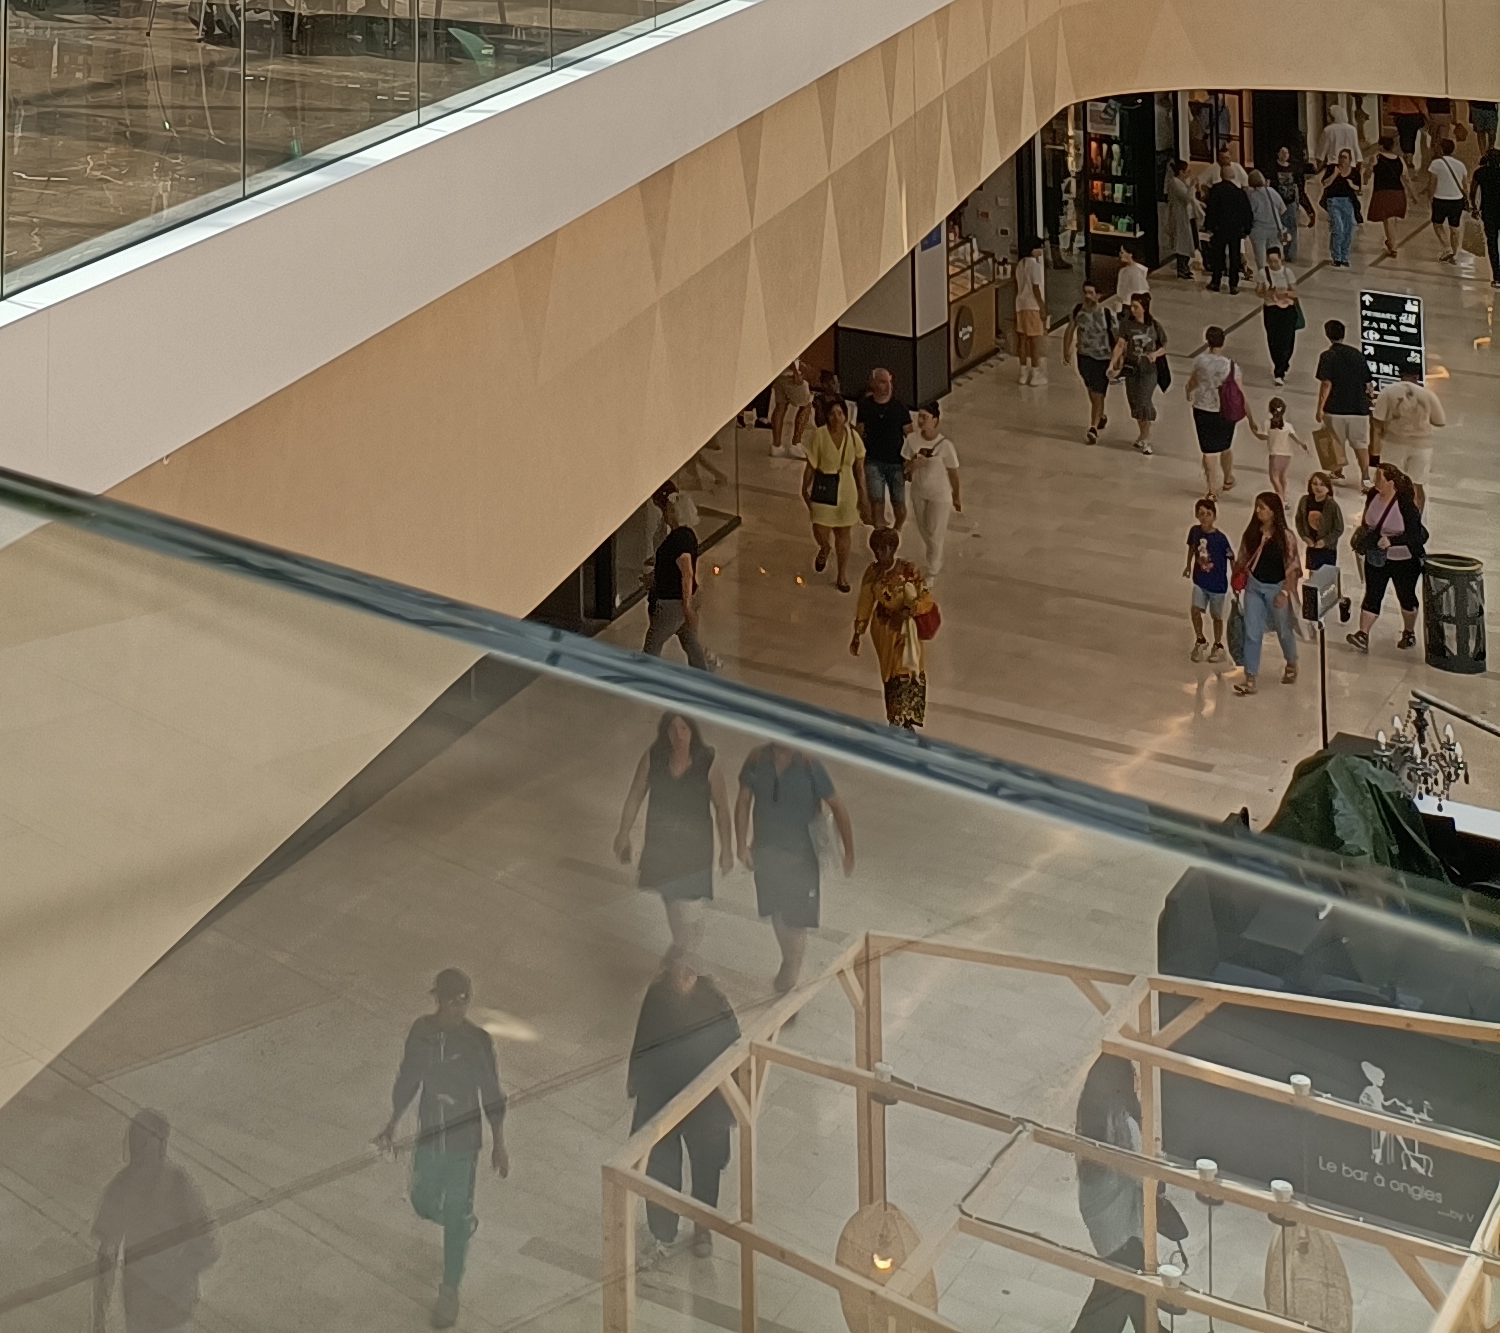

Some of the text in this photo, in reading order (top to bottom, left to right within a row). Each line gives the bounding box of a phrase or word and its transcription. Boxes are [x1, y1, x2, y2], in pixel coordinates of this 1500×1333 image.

[1318, 1155, 1443, 1204] Le bar à ongles
